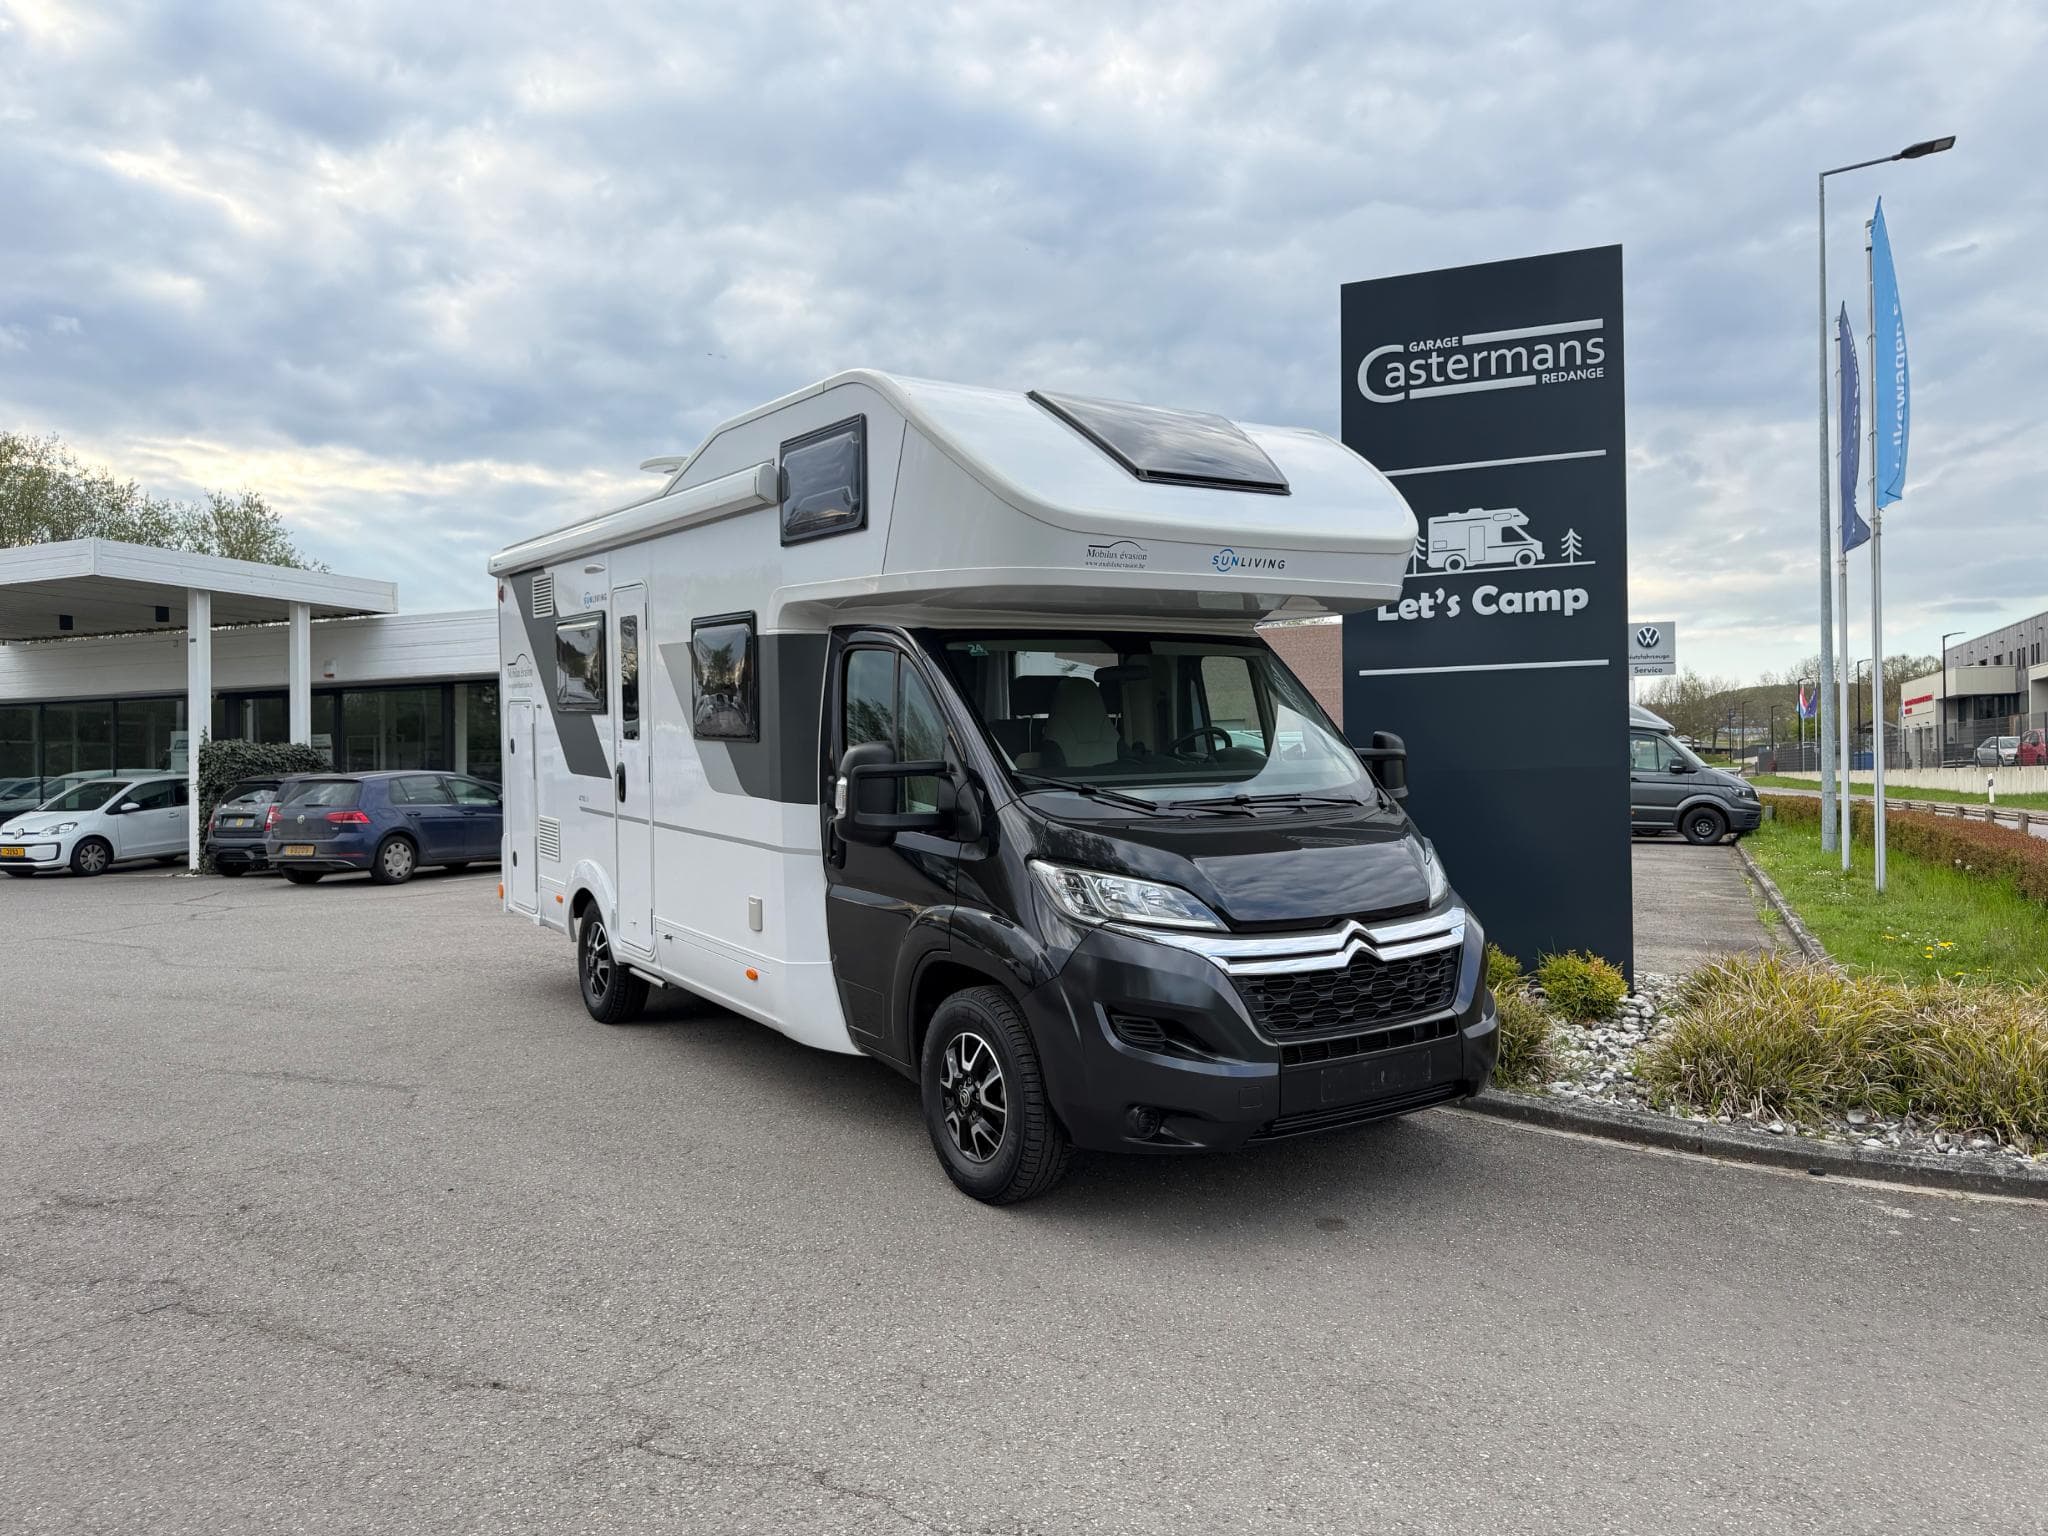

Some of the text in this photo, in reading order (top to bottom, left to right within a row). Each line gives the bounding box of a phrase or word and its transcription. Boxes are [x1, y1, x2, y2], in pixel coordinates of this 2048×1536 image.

[1408, 336, 1460, 353] GARAGE
[1357, 337, 1605, 403] Castermans
[1541, 367, 1605, 384] REDANGE
[1212, 554, 1286, 570] SUNLIVING
[1472, 584, 1590, 616] Camp
[1634, 665, 1663, 674] Service
